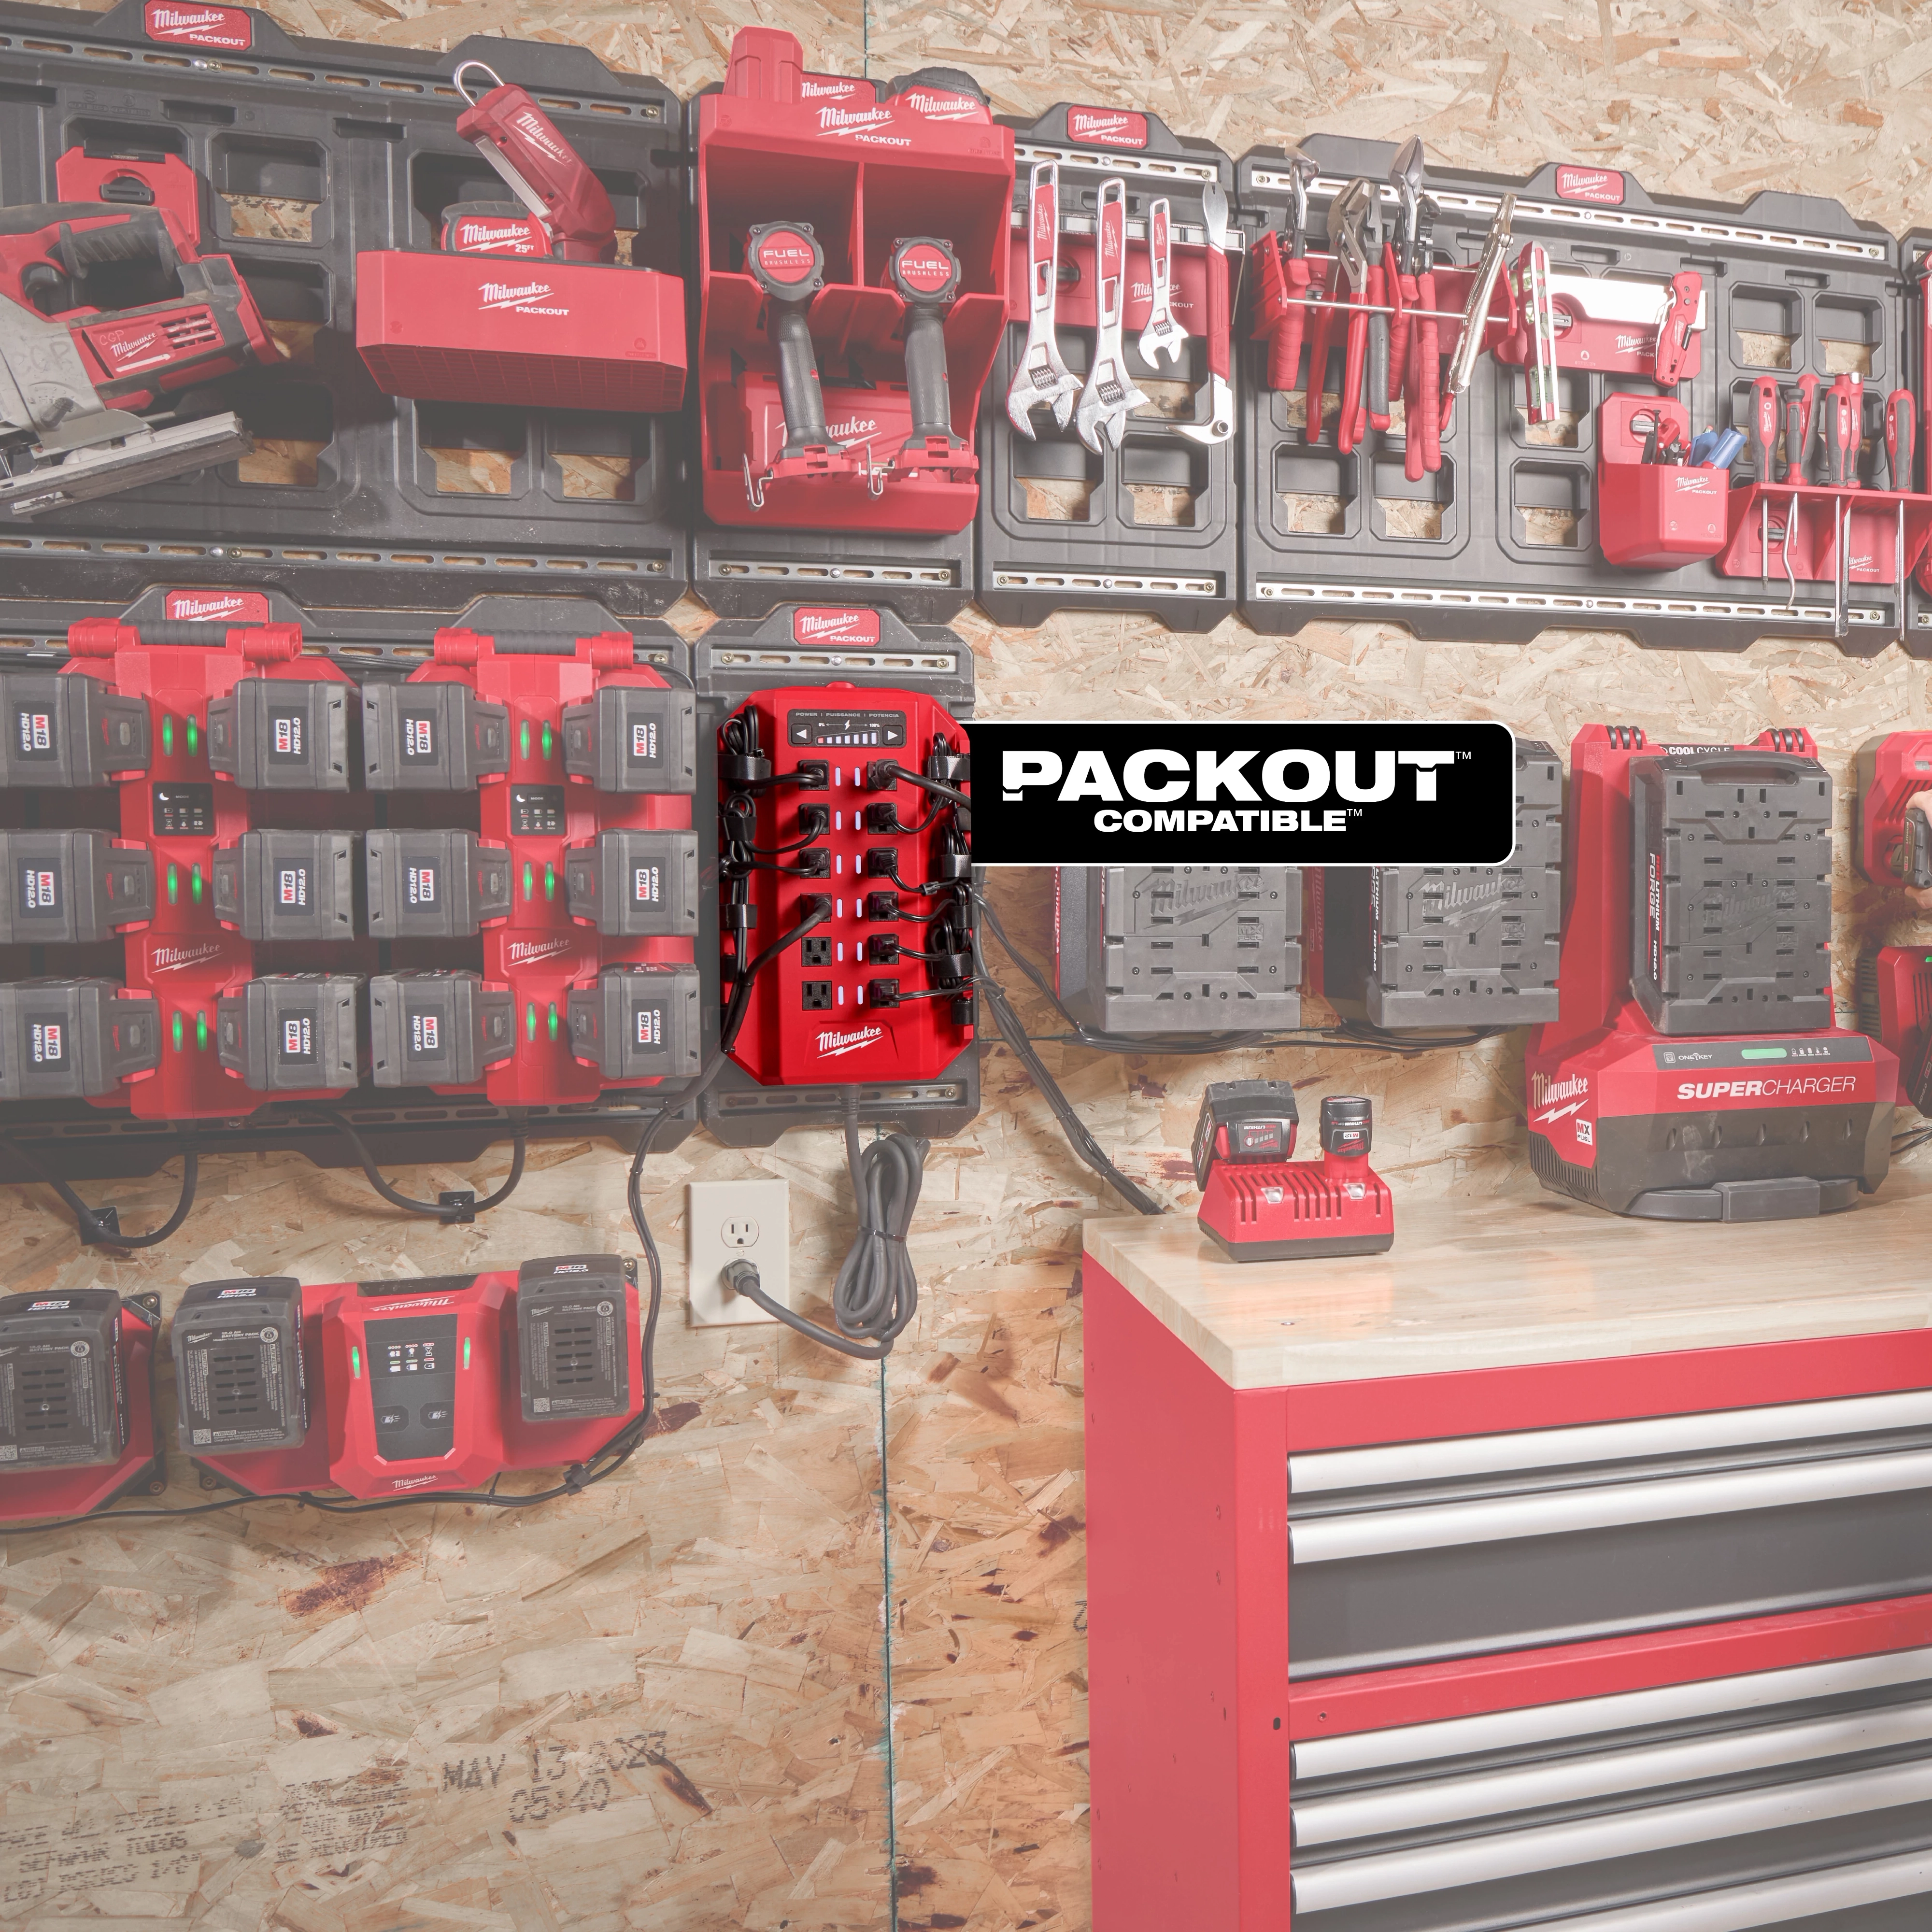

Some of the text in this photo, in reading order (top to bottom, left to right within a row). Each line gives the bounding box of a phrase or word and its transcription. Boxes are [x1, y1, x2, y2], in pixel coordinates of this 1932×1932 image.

[151, 9, 226, 27] Milwaukee
[189, 33, 246, 46] PACKOUT
[816, 106, 893, 128] Milwaukee
[905, 93, 976, 113] Milwaukee
[1072, 114, 1129, 129] Milwaukee
[854, 133, 912, 146] PACKOUT
[1101, 134, 1143, 145] PACKOUT
[1561, 172, 1608, 189] Milwaukee
[1584, 192, 1620, 202] PACKOUT
[459, 223, 531, 244] Milwaukee
[763, 248, 810, 258] FUEL
[901, 260, 950, 270] FUEL
[478, 281, 552, 303] Milwaukee
[516, 306, 569, 316] PACKOUT
[110, 331, 158, 357] Milwaukee
[1675, 475, 1709, 488] Milwaukee
[172, 597, 244, 617] Milwaukee
[799, 613, 860, 634] Milwaukee
[22, 713, 31, 752] HD12.0
[33, 715, 49, 748] M18
[276, 720, 291, 752] M18
[292, 717, 301, 754] HD12.0
[406, 719, 415, 756] HD12.0
[417, 721, 431, 753] M18
[633, 725, 647, 756] M18
[648, 723, 657, 759] HD12.0
[26, 870, 36, 909] HD12.0
[39, 872, 54, 906] M18
[282, 871, 296, 903] M18
[298, 868, 307, 906] HD12.0
[409, 867, 417, 904] HD12.0
[420, 869, 434, 901] M18
[636, 868, 649, 900] M18
[651, 867, 660, 903] HD12.0
[1142, 873, 1265, 915] Milwaukee
[1420, 874, 1526, 916] Milwaukee
[1238, 924, 1262, 935] MX
[151, 943, 221, 966] Milwaukee
[507, 938, 570, 959] Milwaukee
[286, 1021, 300, 1053] M18
[302, 1018, 311, 1055] HD12.0
[412, 1015, 421, 1051] HD12.0
[424, 1016, 438, 1049] M18
[638, 1012, 652, 1043] M18
[653, 1009, 661, 1045] HD12.0
[815, 1026, 882, 1052] Milwaukee
[32, 1024, 43, 1062] HD12.0
[45, 1025, 61, 1059] M18
[1531, 1071, 1589, 1109] Milwaukee
[1677, 1076, 1856, 1100] SUPERCHARGER
[1577, 1122, 1591, 1136] MX
[1577, 1134, 1591, 1143] FUEL
[1337, 1140, 1364, 1154] Milwaukee
[373, 1297, 452, 1312] Milwaukee
[393, 1474, 437, 1488] Milwaukee
[443, 1753, 507, 1794] MAY
